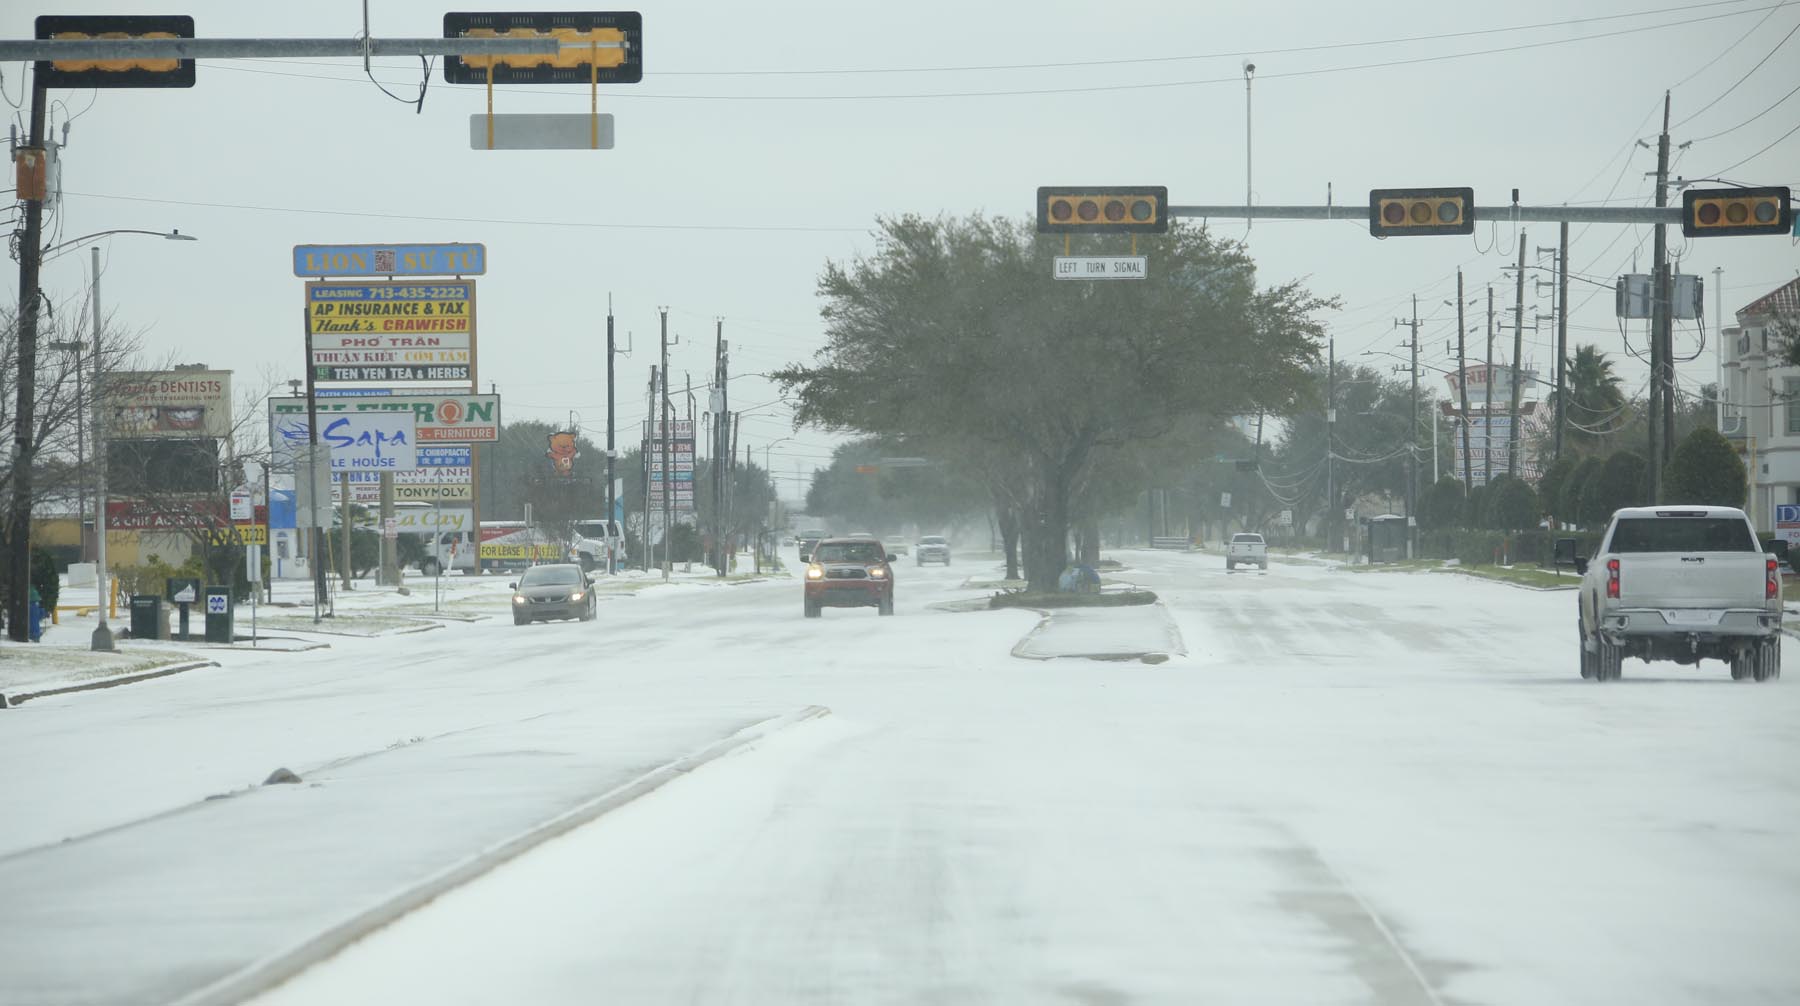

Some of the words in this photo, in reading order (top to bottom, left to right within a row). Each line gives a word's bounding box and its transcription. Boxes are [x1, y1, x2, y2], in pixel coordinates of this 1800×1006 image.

[305, 251, 367, 271] LION
[1059, 262, 1078, 273] LEFT
[1086, 262, 1106, 273] TURN
[1113, 262, 1141, 273] SIGNAL
[315, 289, 363, 298] LEASING
[368, 287, 465, 299] 713-435-2222
[315, 303, 334, 316] AP
[338, 303, 418, 316] INSURANCE
[423, 303, 434, 315] &
[438, 302, 464, 315] TAX
[315, 319, 377, 332] Hank's
[383, 319, 467, 331] CRAWFISH
[334, 368, 359, 379] TEN
[362, 368, 387, 379] YEN
[390, 368, 413, 379] TEA
[416, 370, 424, 379] &
[428, 367, 467, 379] HERBS
[160, 381, 221, 393] DENTISTS
[434, 427, 491, 438] FURNITURE
[425, 448, 470, 457] CHIROPRACTIC
[352, 458, 395, 467] HOUSE
[433, 468, 470, 477] ANH
[396, 488, 465, 497] TONYMOLY
[481, 546, 497, 556] FOR
[497, 546, 521, 556] LEASE
